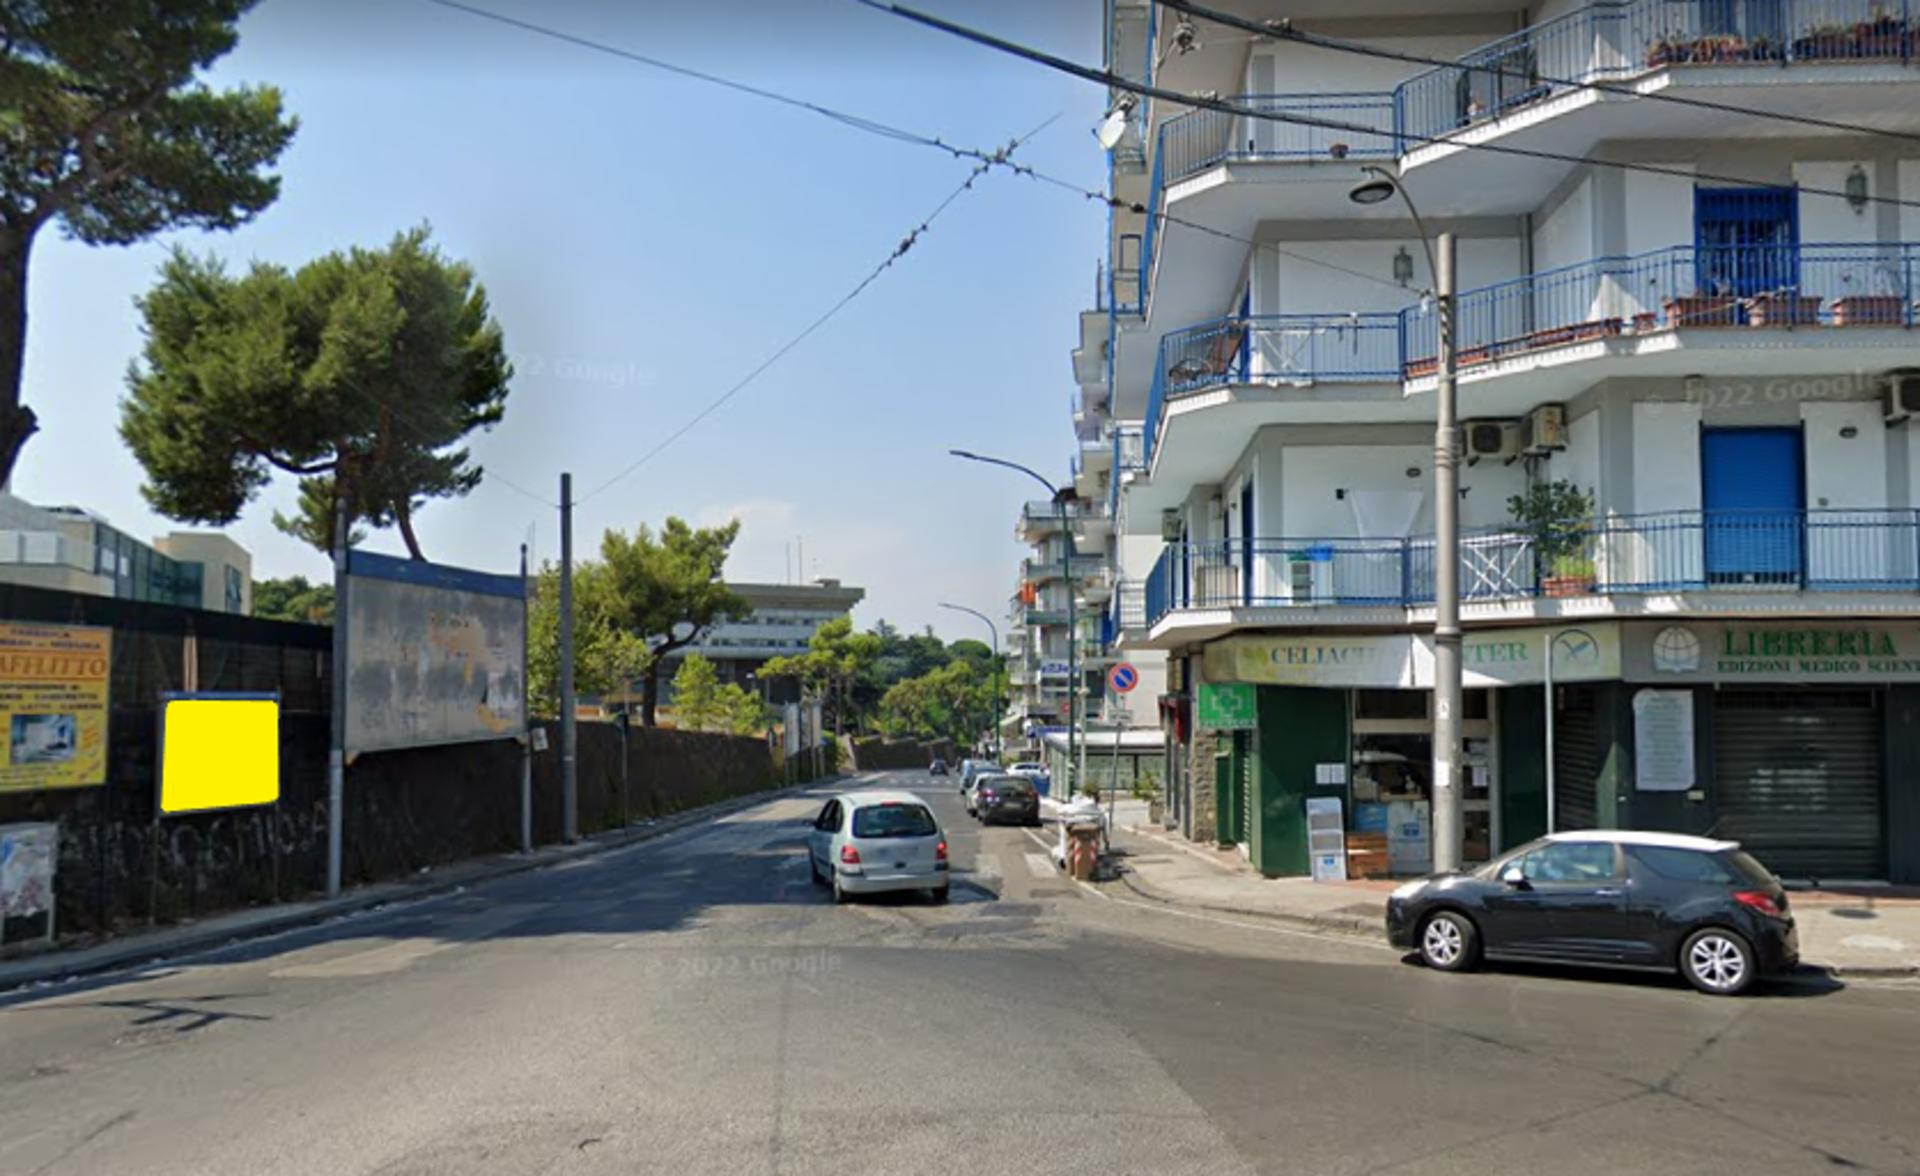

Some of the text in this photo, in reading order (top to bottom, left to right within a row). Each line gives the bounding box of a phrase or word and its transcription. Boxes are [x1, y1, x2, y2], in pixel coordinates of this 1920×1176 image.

[1724, 629, 1897, 656] LIBRERIA
[1718, 660, 1791, 673] EDIZIONI
[1799, 660, 1861, 673] MEDICO
